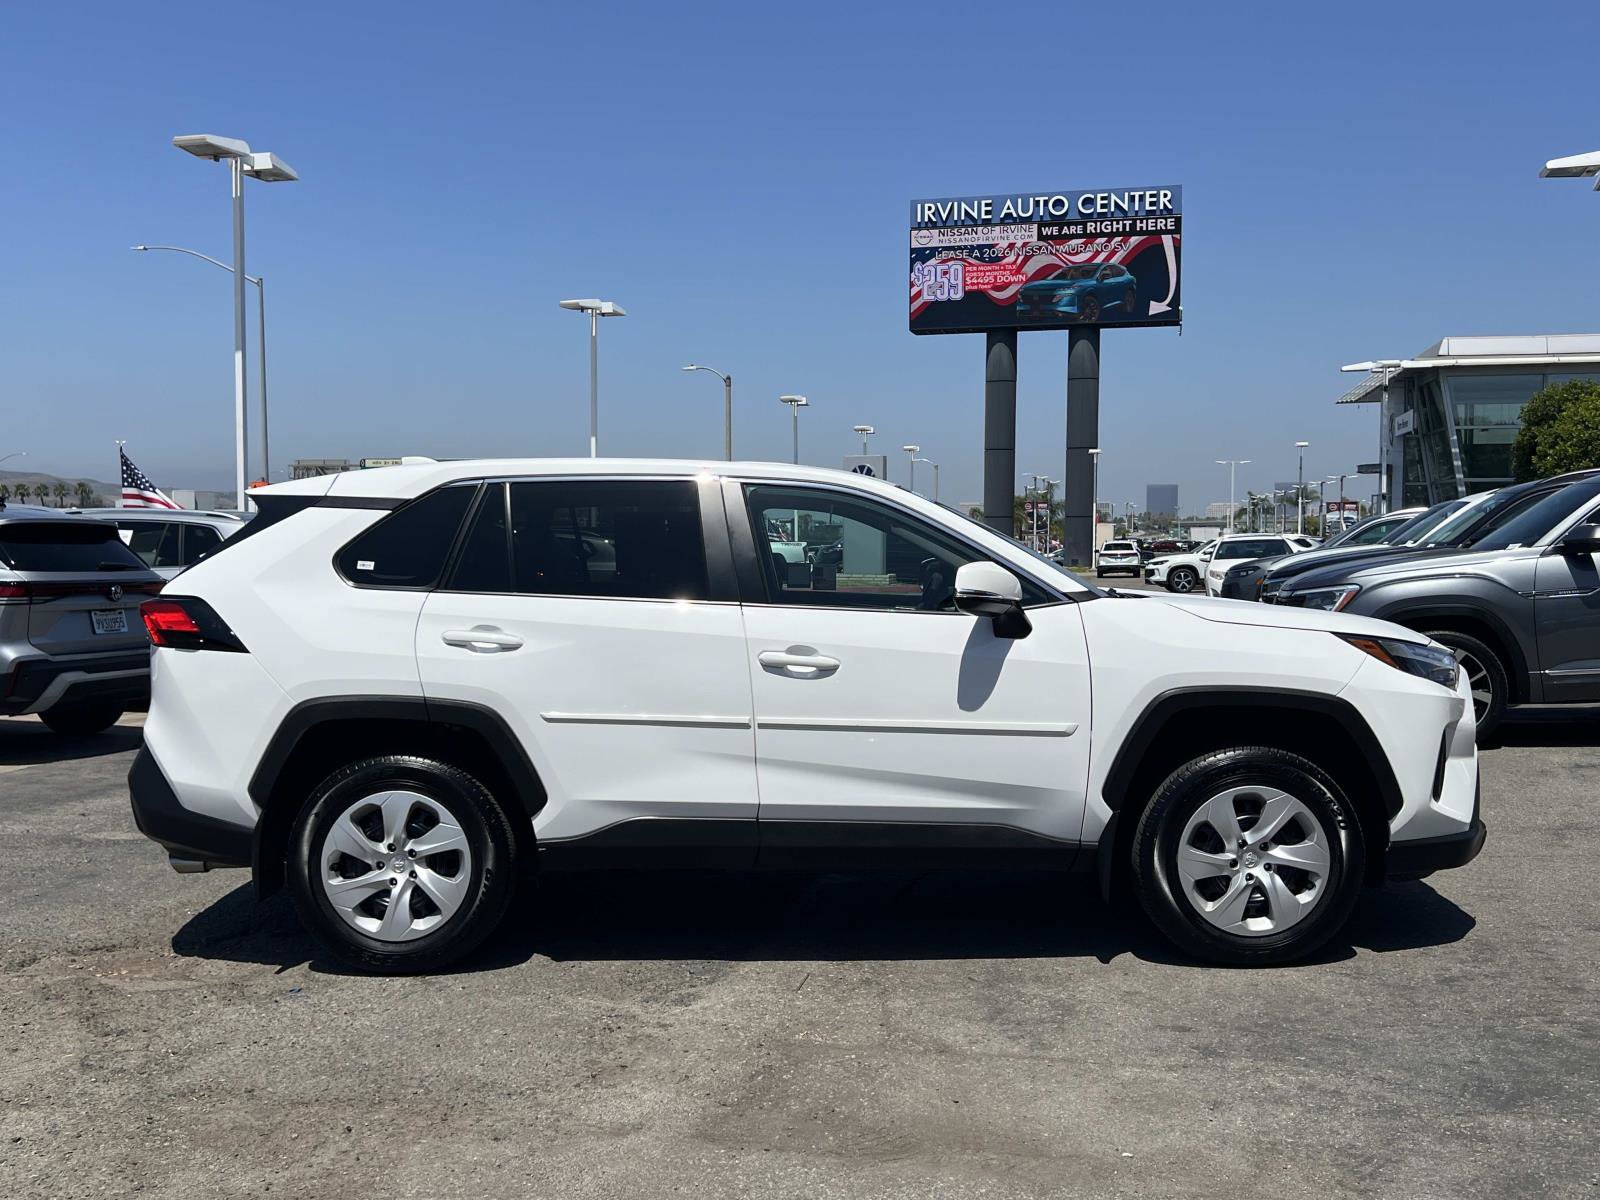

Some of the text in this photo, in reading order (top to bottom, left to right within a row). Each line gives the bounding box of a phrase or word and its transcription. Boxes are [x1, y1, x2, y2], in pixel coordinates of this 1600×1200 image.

[917, 190, 1173, 222] IRVINE AUTO CENTER
[937, 225, 1034, 238] NISSAN OF IRVINE
[1041, 218, 1175, 236] WE ARE RIGHT HERE
[935, 242, 1131, 260] LEASE A 2026 NISSAN MURANO SV
[912, 261, 965, 302] $259
[965, 274, 1026, 284] $4495 DOWN
